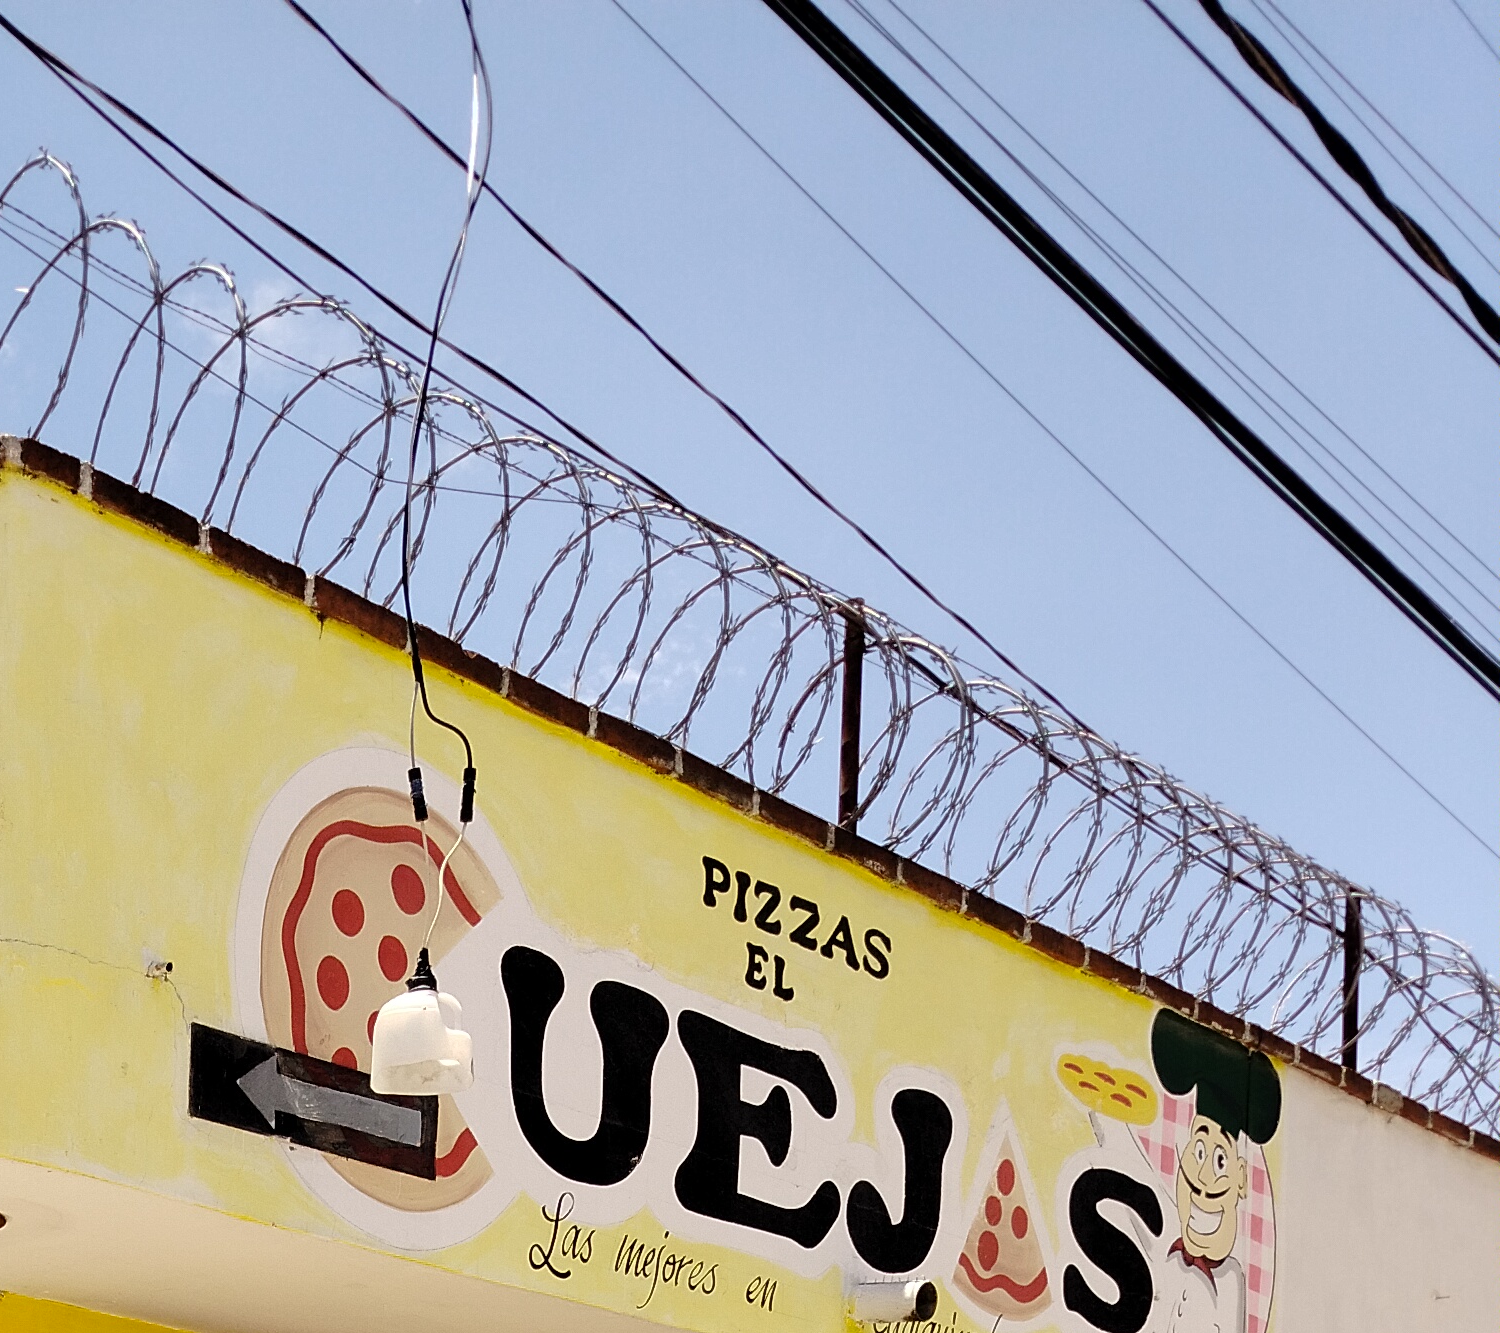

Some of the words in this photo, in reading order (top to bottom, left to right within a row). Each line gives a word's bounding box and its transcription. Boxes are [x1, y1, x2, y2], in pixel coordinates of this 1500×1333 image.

[702, 856, 892, 980] PIZZAS
[745, 942, 794, 1001] EL
[528, 1191, 594, 1279] Las
[615, 1231, 720, 1309] mejores
[745, 1275, 779, 1312] en
